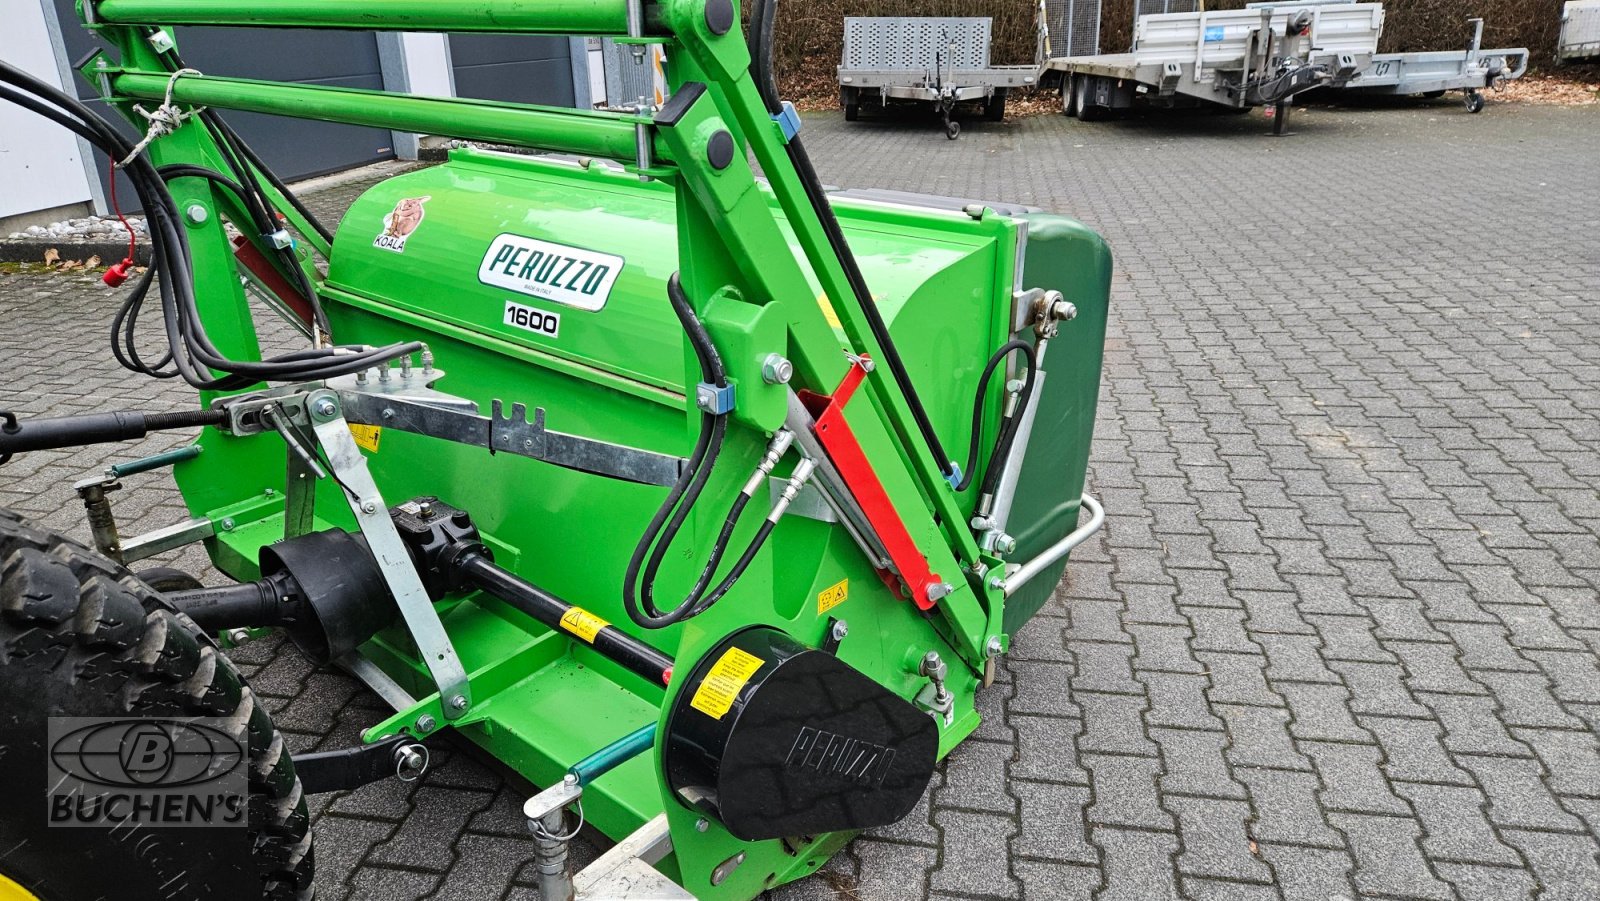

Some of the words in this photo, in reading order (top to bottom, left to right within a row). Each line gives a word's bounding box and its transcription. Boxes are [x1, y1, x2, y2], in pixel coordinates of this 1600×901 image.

[374, 235, 405, 251] KOALA
[488, 243, 610, 296] PERUZZO
[507, 306, 558, 334] 1600
[784, 726, 897, 786] PERUZZO
